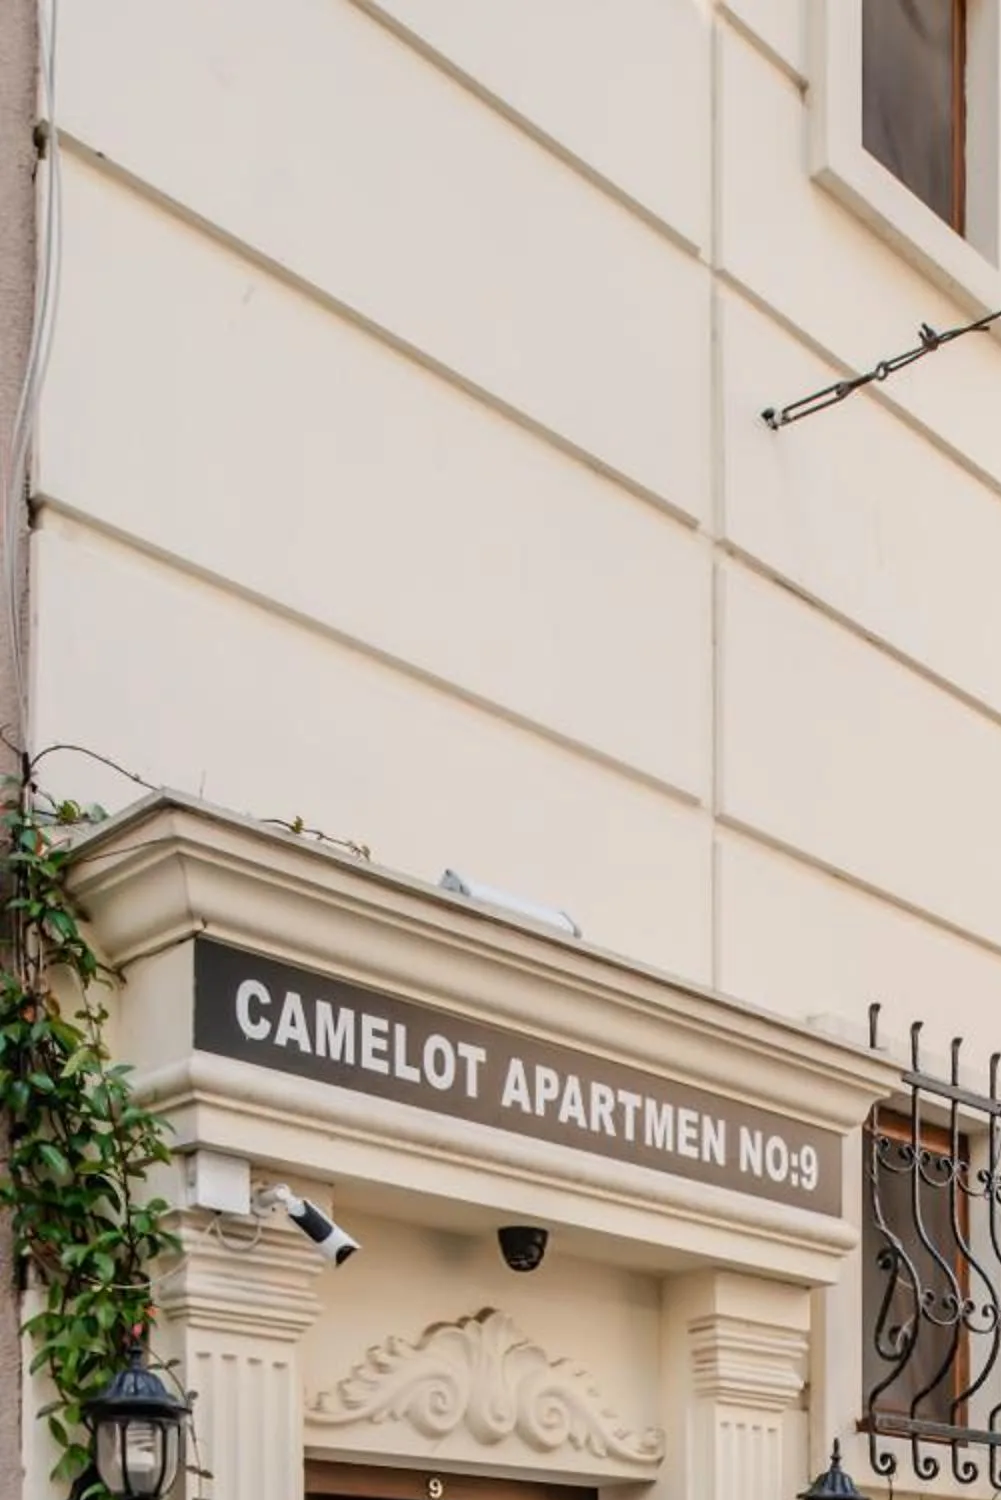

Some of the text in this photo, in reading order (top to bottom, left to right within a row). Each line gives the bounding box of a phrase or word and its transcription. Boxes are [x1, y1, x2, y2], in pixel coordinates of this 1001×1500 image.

[235, 979, 819, 1191] CAMELOT APARTMEN NO:9
[429, 1478, 443, 1499] 9
